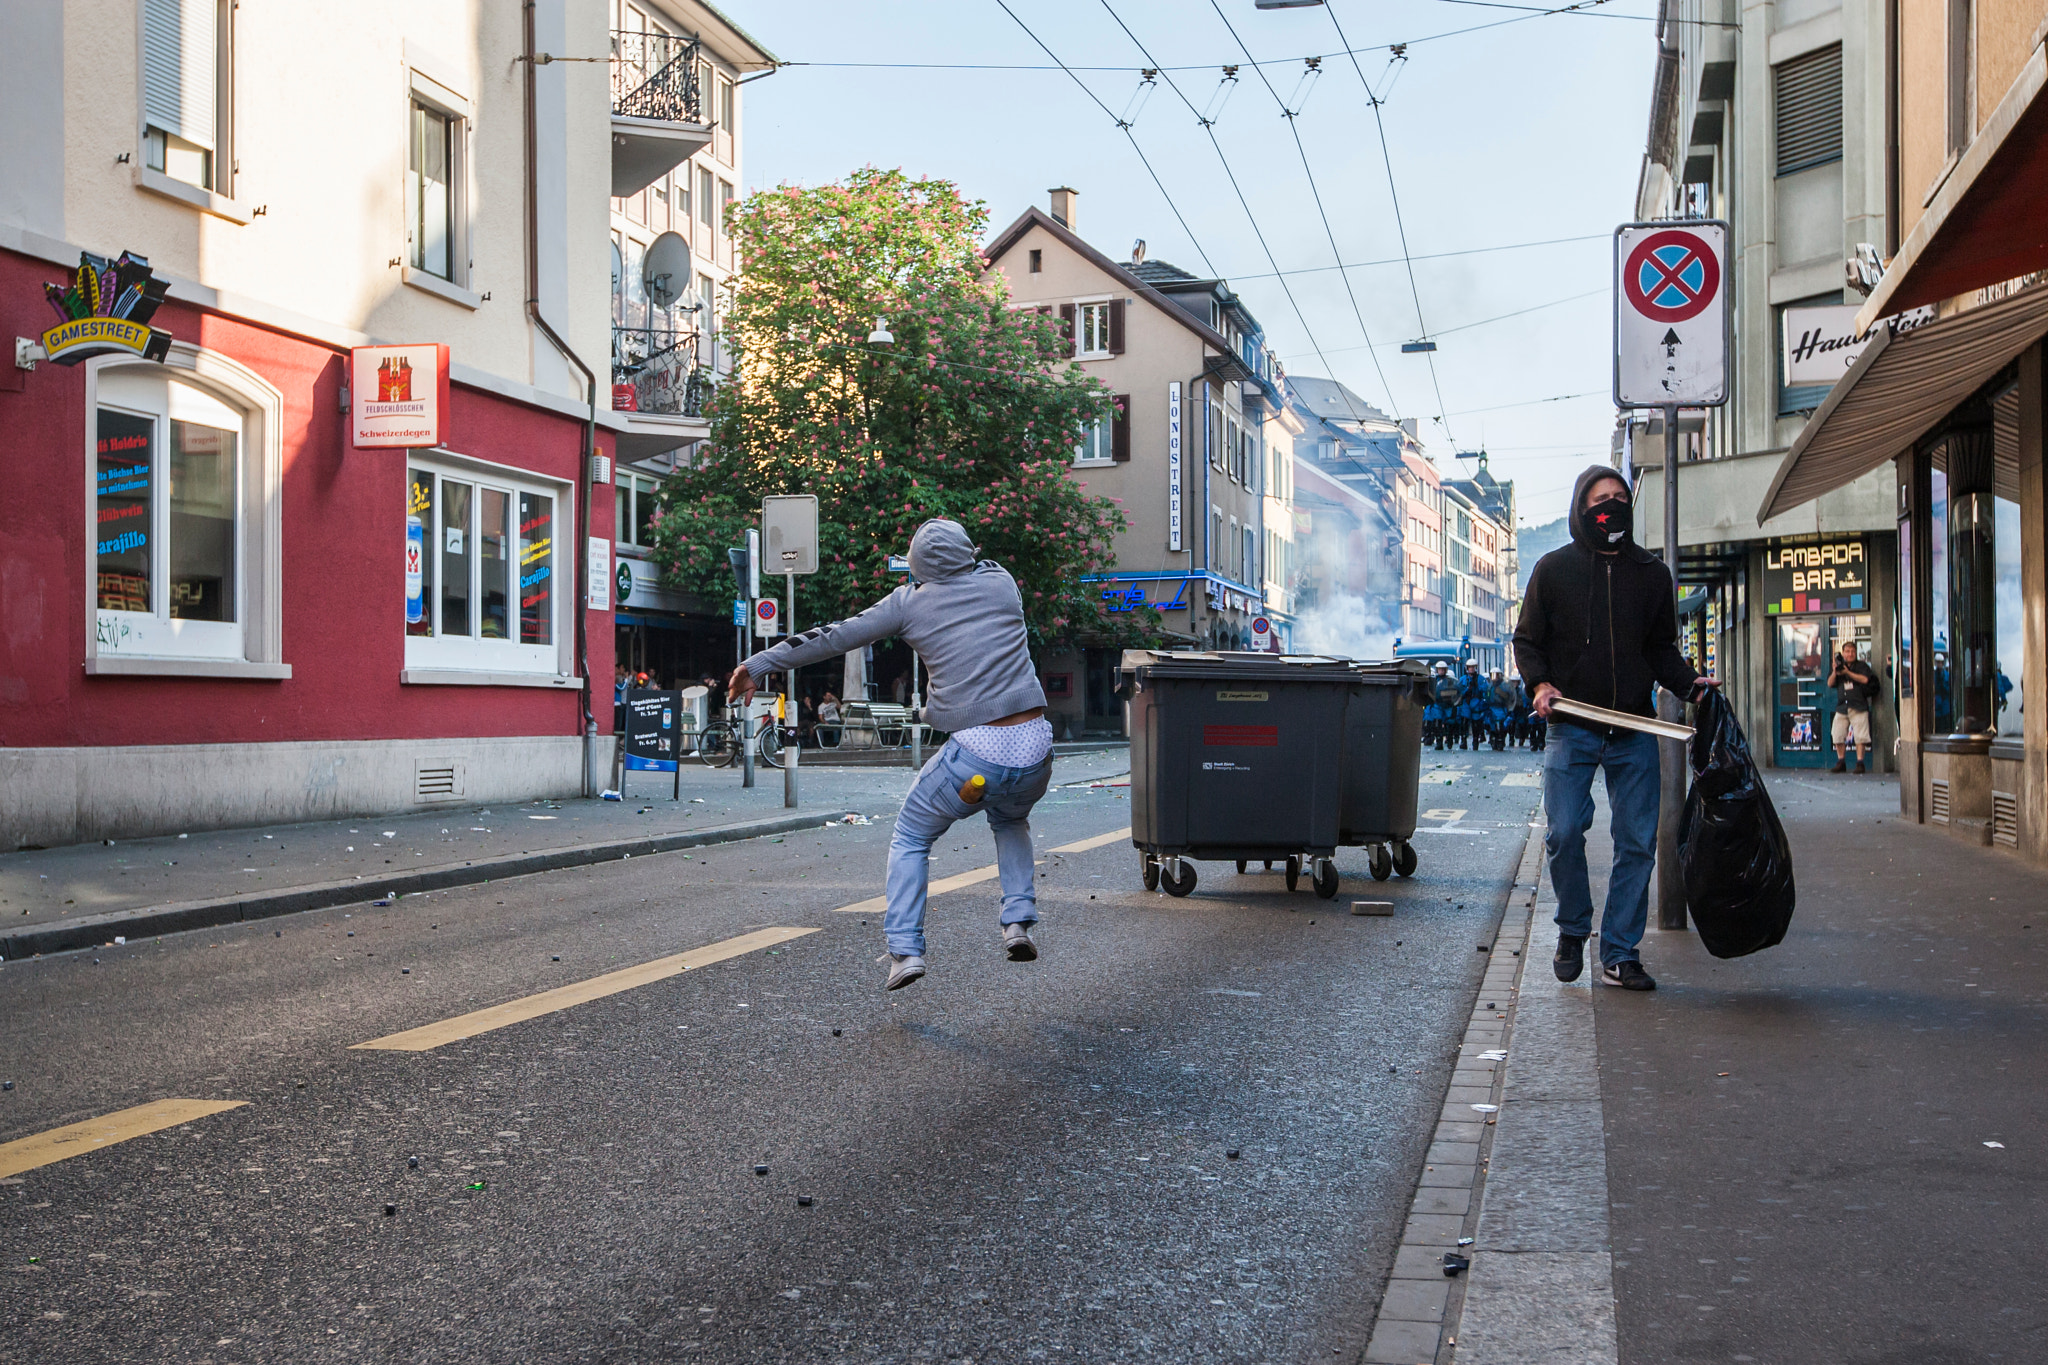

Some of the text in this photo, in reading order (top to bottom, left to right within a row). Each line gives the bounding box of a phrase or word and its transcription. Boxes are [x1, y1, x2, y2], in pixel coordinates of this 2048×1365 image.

[50, 321, 143, 347] GAMESTREET
[366, 404, 424, 413] FELDSCHLÖSSCHEN
[110, 435, 147, 451] Holdrio
[360, 429, 430, 438] Schweizerdegen
[134, 465, 149, 475] Bier
[1171, 391, 1180, 542] LONGSTREET
[97, 531, 146, 554] arajillo
[1768, 543, 1863, 570] LAMBADA
[520, 566, 549, 588] Carajillo
[1793, 569, 1835, 591] BAR
